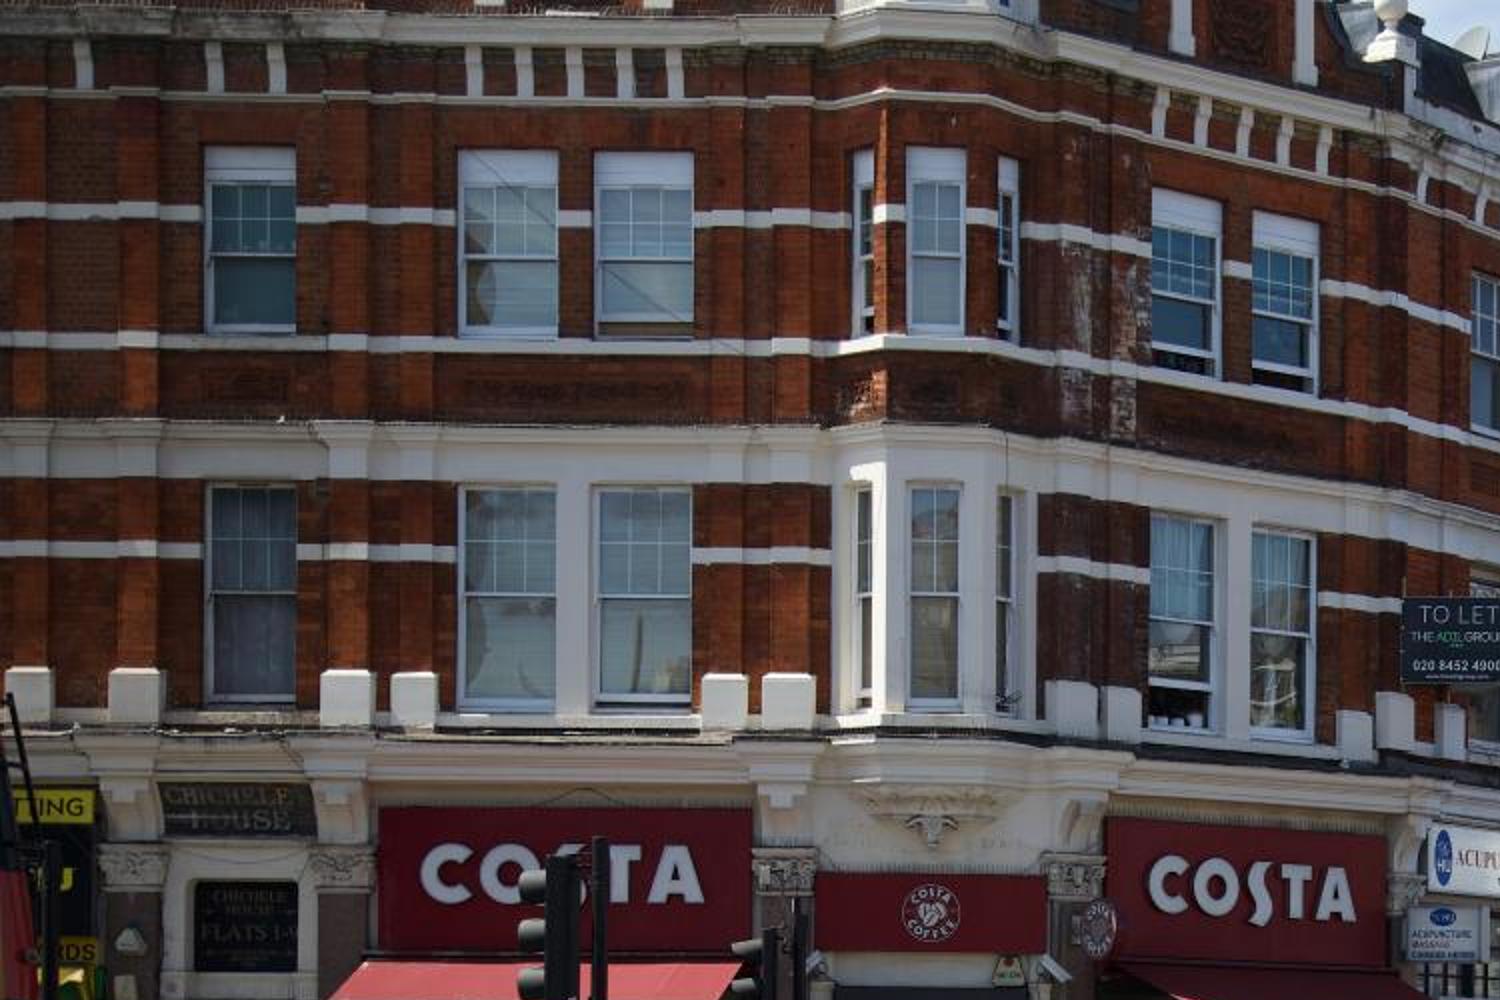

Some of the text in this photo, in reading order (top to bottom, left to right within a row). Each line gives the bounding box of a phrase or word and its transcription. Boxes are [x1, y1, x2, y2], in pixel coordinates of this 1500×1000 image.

[1420, 605, 1500, 625] TO LET
[1411, 631, 1435, 643] THE
[1413, 660, 1435, 671] 020
[1438, 660, 1469, 671] 8452
[1149, 855, 1358, 927] COSTA
